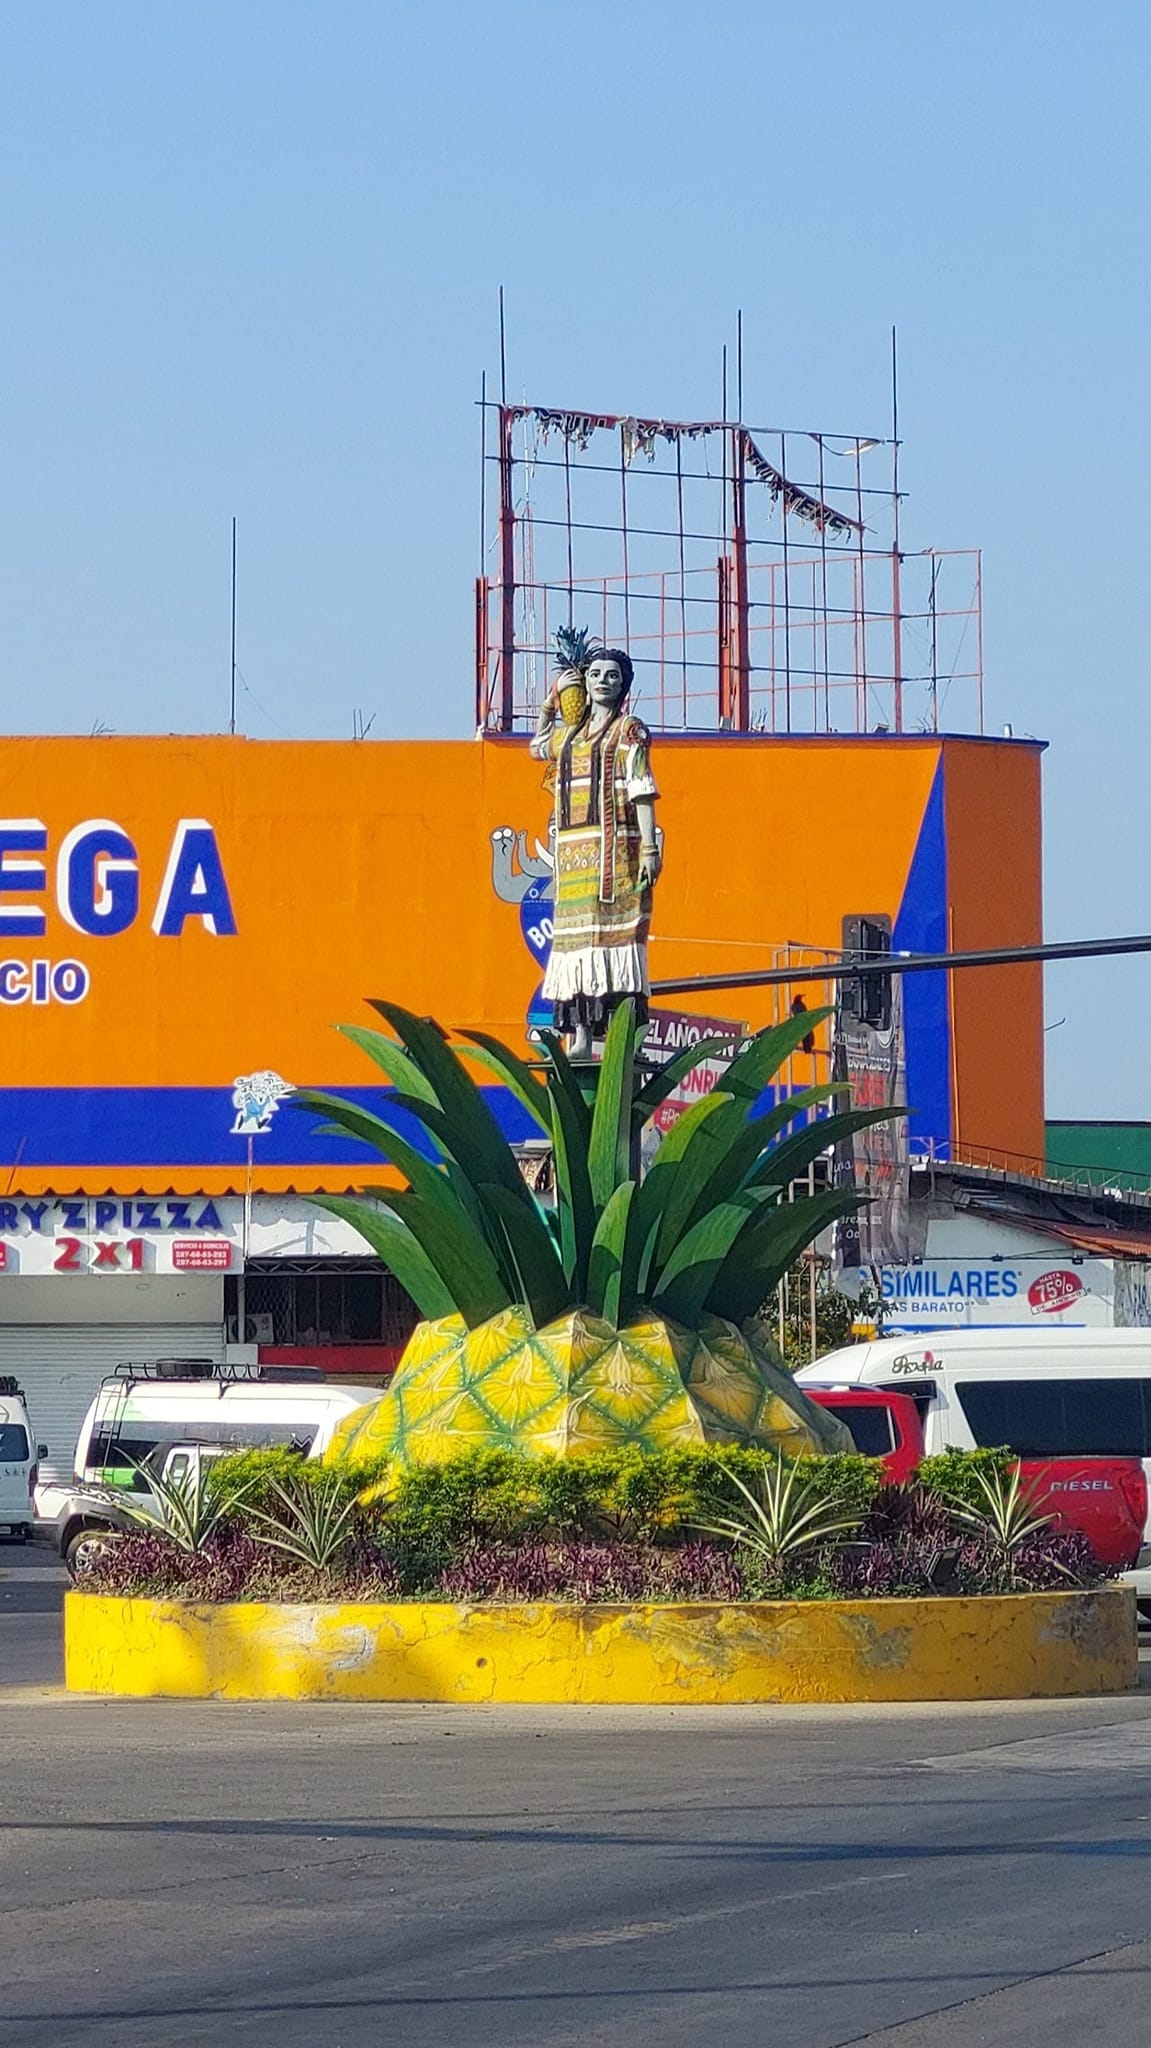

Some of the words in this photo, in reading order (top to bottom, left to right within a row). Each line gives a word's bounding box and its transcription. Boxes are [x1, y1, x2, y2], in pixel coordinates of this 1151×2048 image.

[0, 818, 239, 936] EGA
[0, 959, 90, 1005] CIO
[664, 1018, 700, 1049] AÑO
[96, 1200, 223, 1231] PIZZA
[882, 1270, 1018, 1297] SIMILARES
[1035, 1276, 1074, 1302] 75%
[1050, 1480, 1114, 1492] DIESEL
